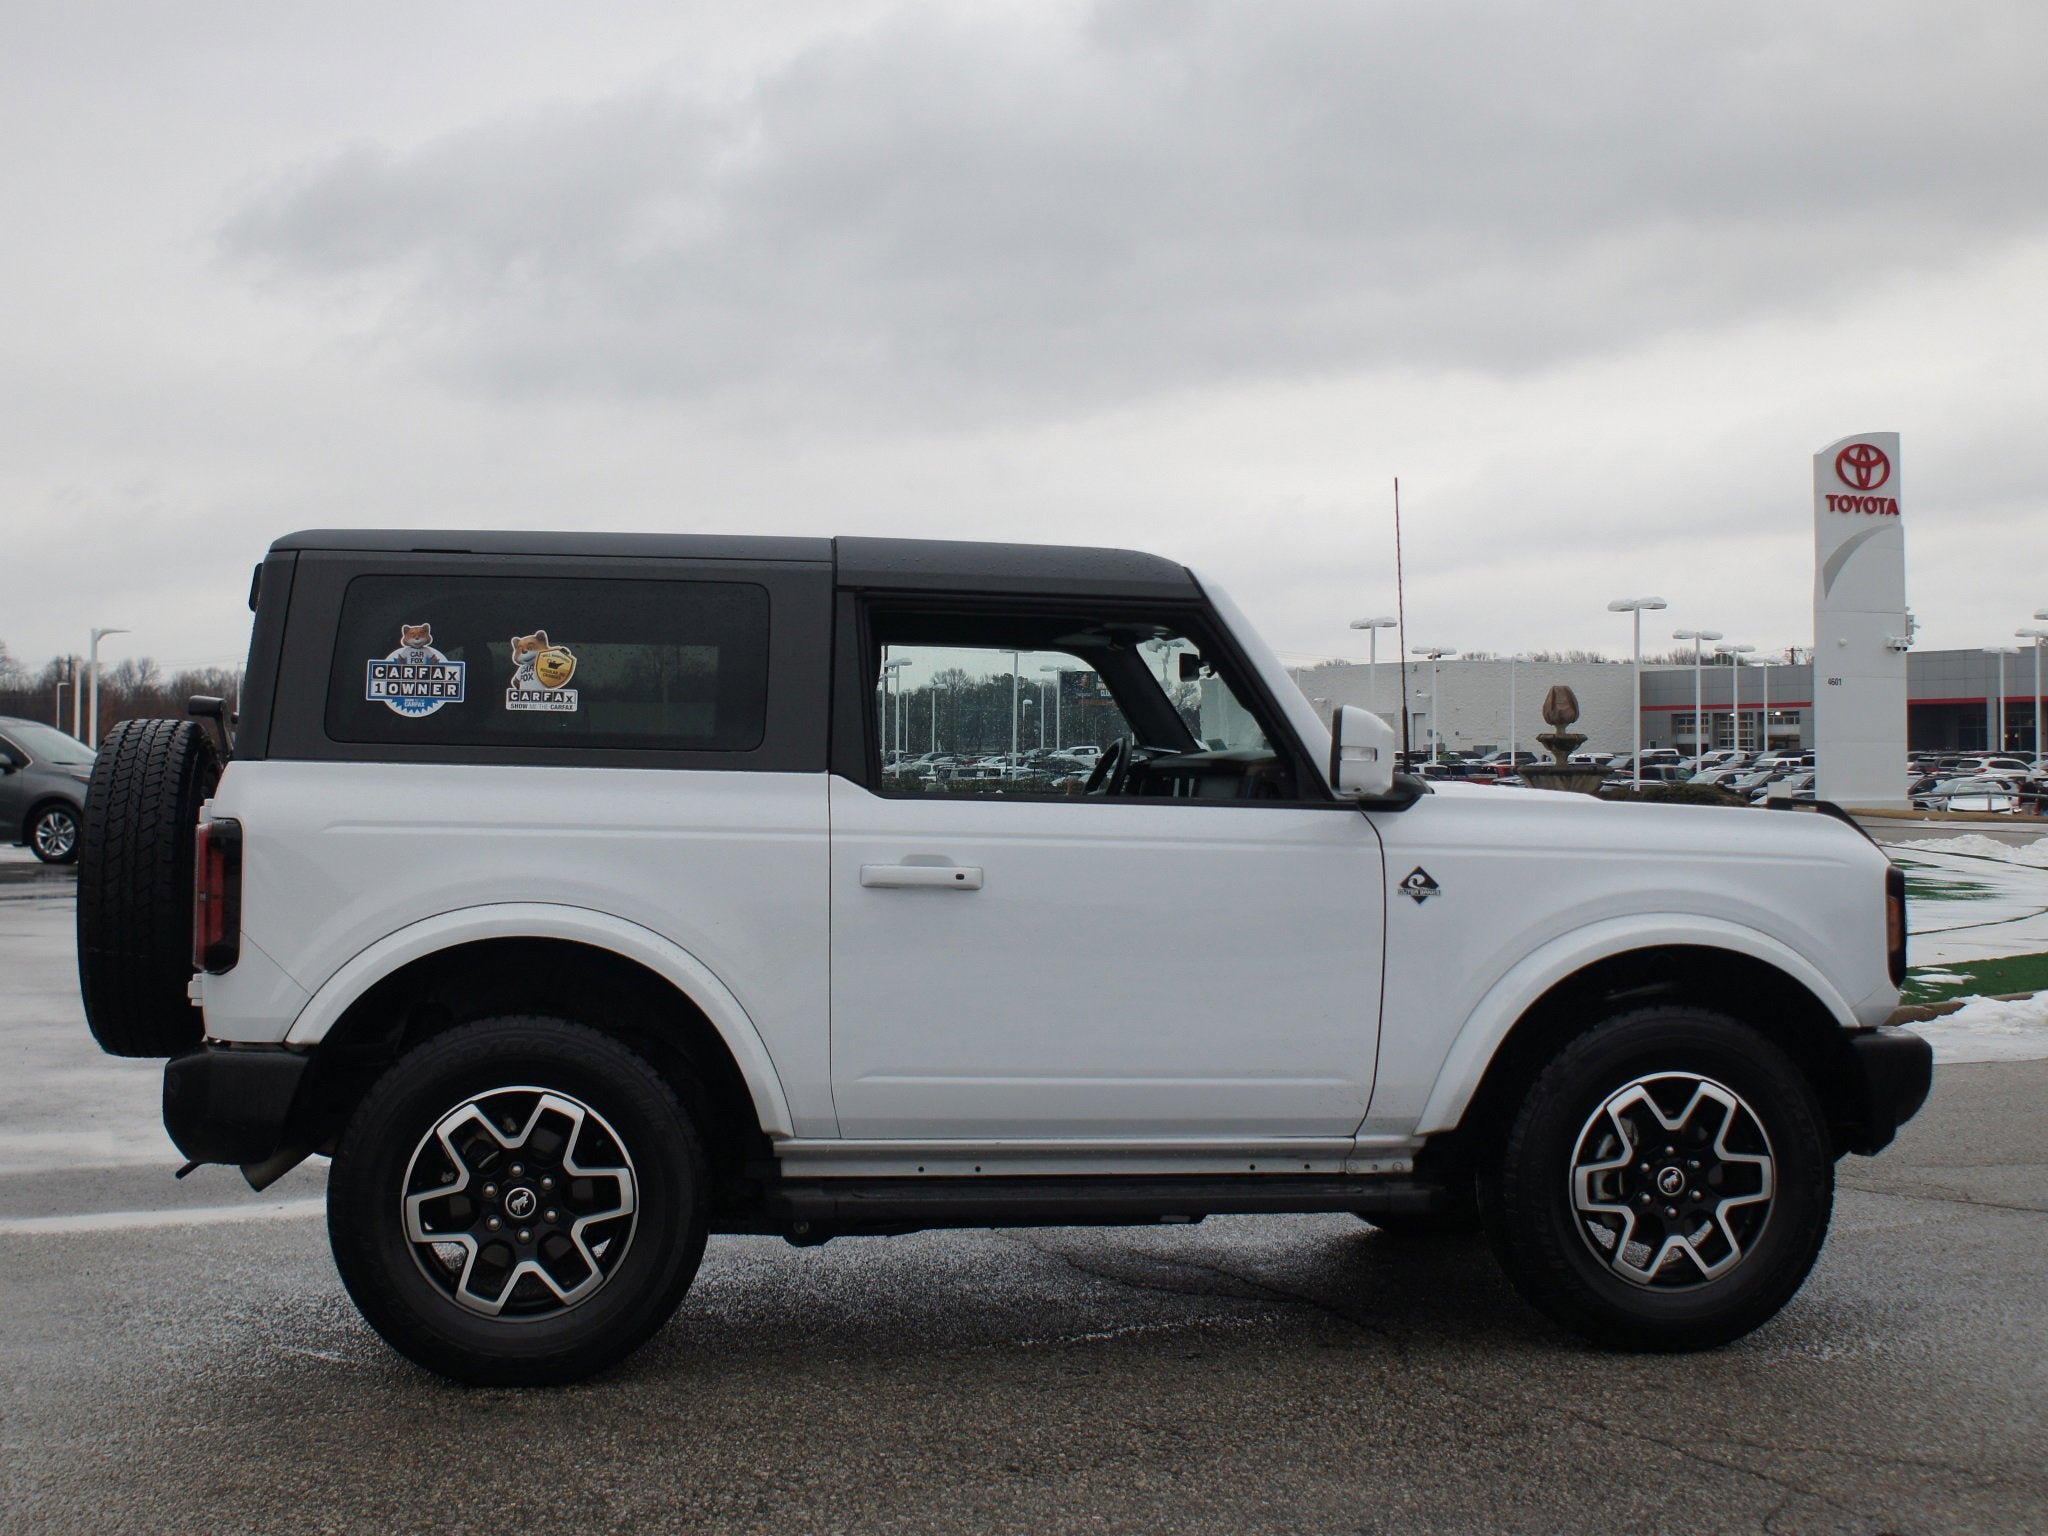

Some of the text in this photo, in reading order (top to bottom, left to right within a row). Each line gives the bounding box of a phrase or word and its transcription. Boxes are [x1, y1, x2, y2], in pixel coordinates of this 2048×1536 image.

[1825, 494, 1900, 516] TOYOTA
[374, 666, 458, 681] CARFAX
[520, 673, 534, 682] FOX
[1828, 677, 1842, 686] 4601
[374, 682, 457, 696] 1 OWNER
[510, 691, 573, 703] CARFAX
